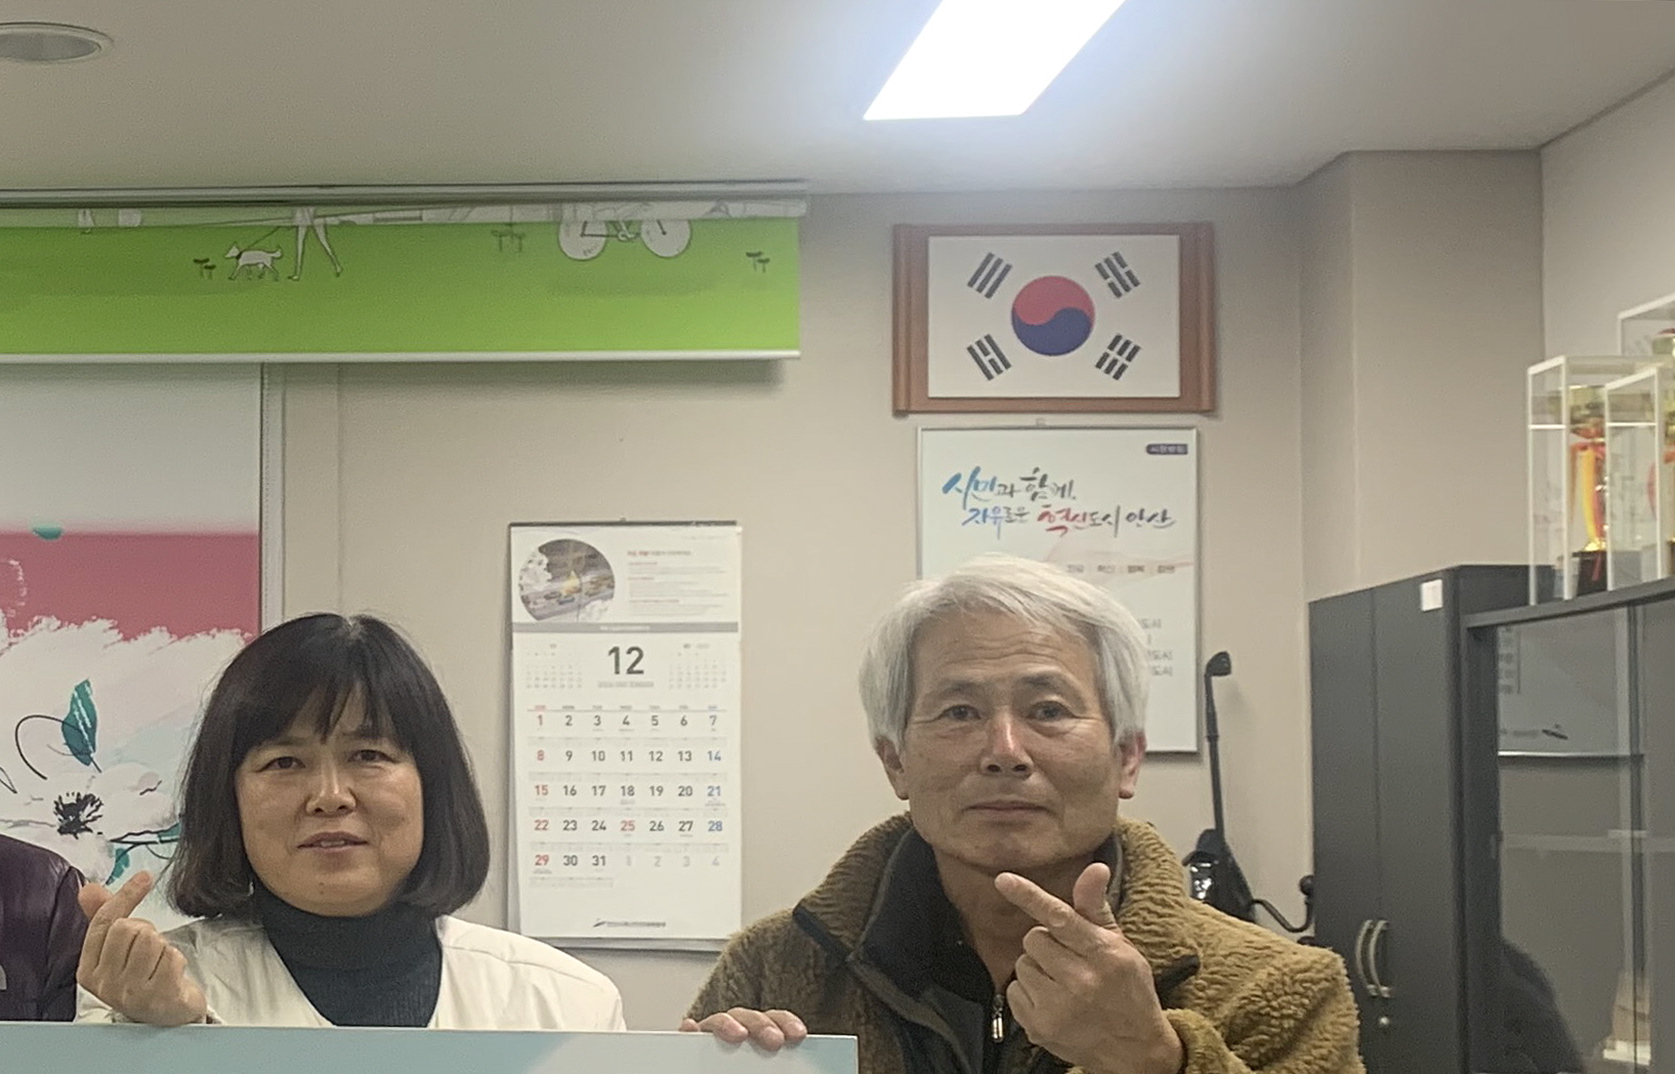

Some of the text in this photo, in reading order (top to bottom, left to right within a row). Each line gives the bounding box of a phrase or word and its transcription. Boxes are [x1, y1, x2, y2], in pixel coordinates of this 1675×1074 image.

[962, 504, 1177, 540] 자유로운 혁신도시 안산
[608, 646, 645, 675] 12
[537, 715, 718, 726] 1 2 3 4 5 6 7
[536, 750, 722, 762] 8 9 10 11 12 13 14
[534, 785, 721, 797] 15 16 17 18 19 20 21
[534, 820, 723, 832] 22 23 24 25 26 27 28
[534, 854, 550, 866] 29
[563, 855, 578, 866] 30
[591, 855, 606, 866] 31
